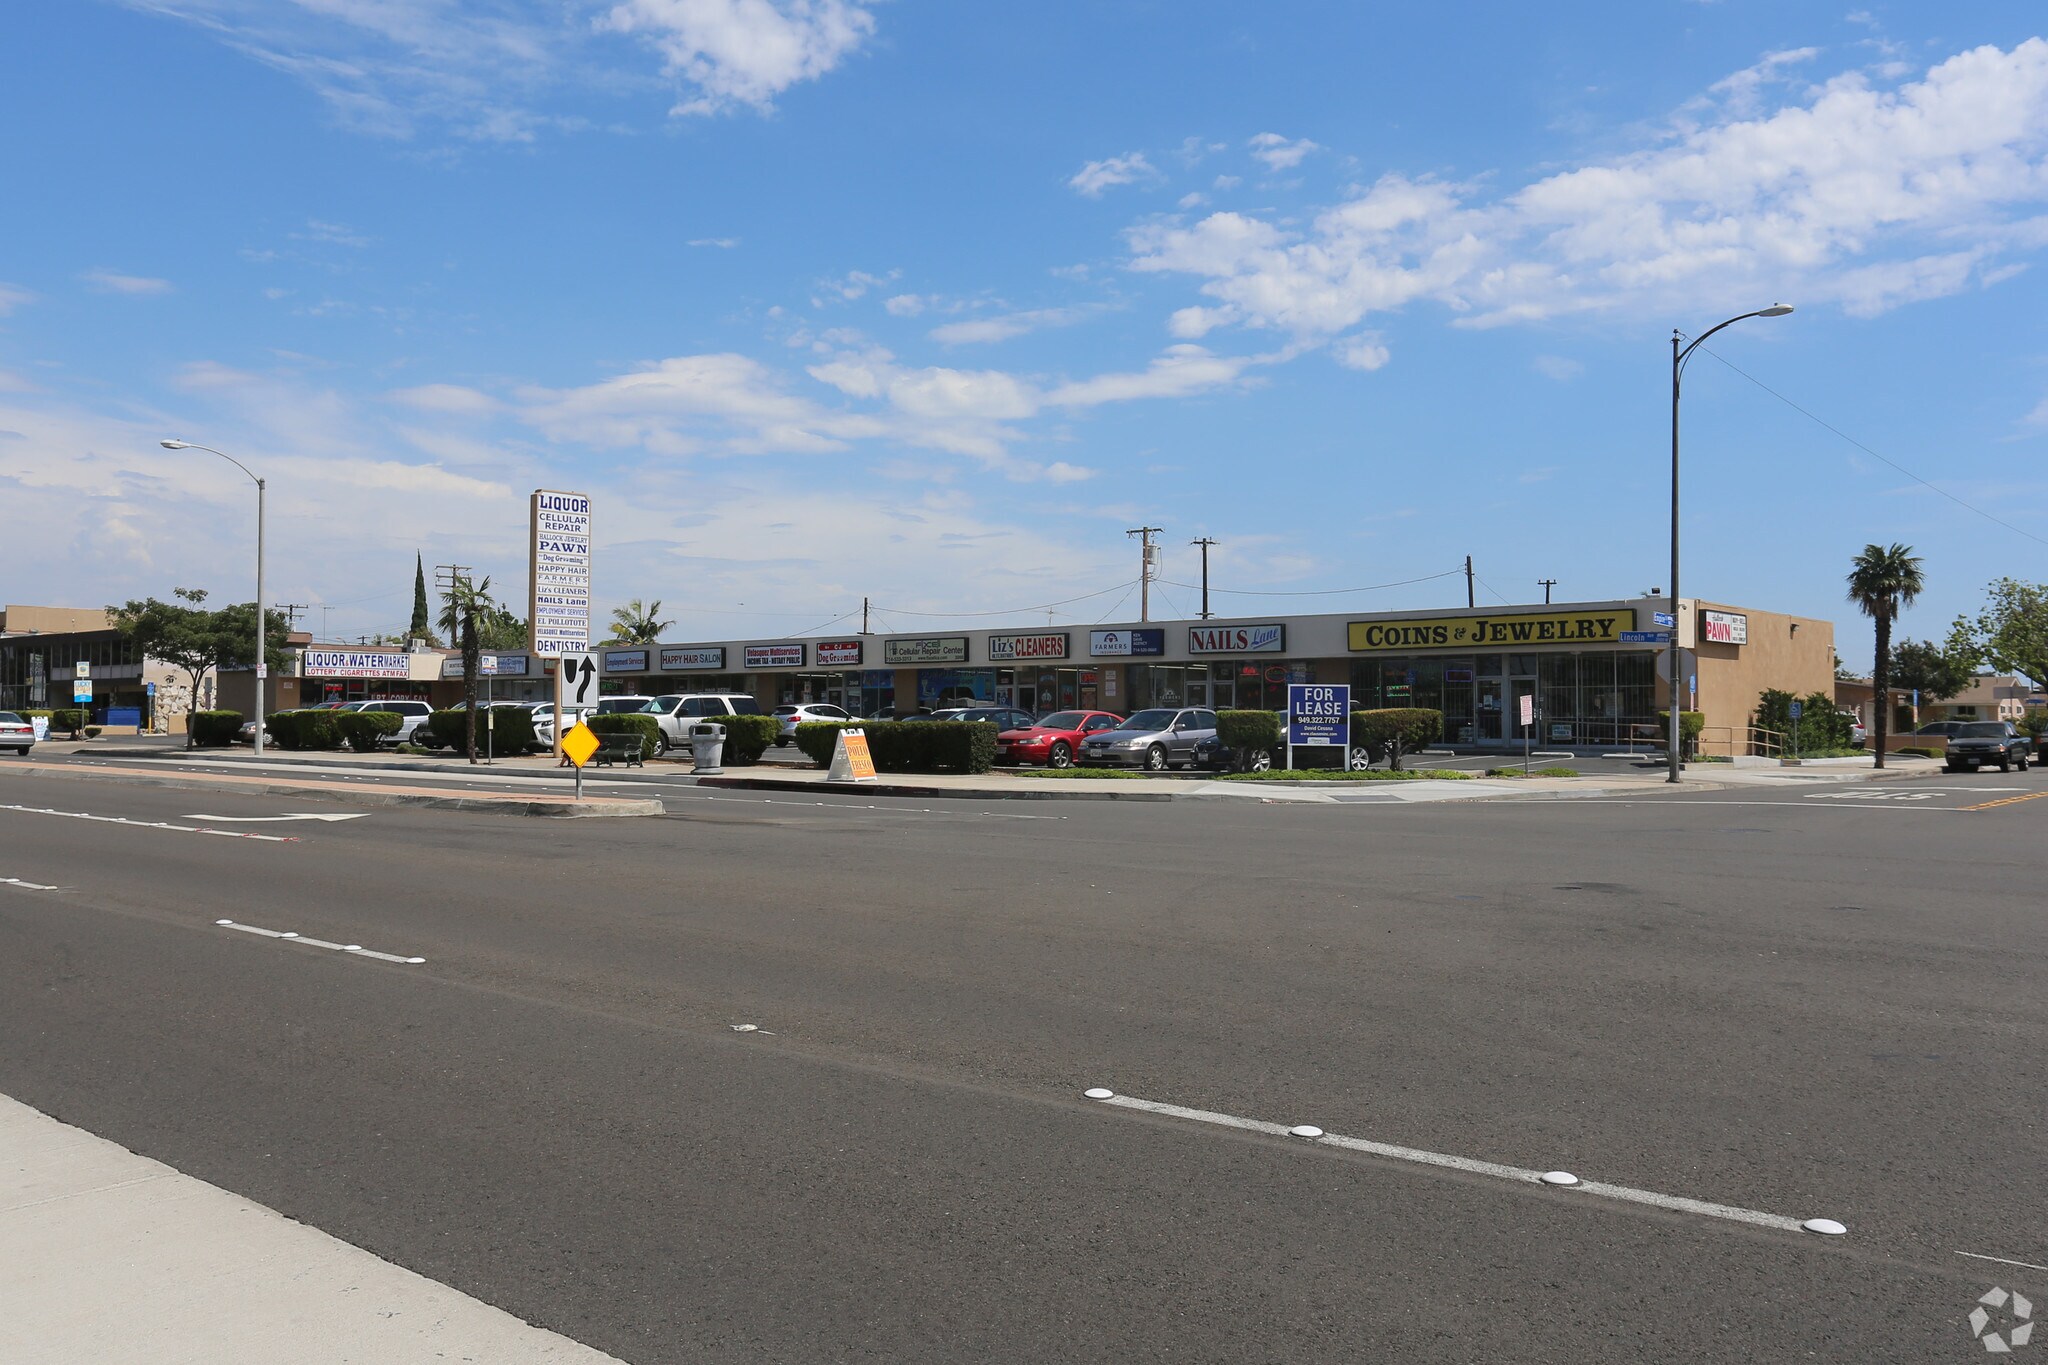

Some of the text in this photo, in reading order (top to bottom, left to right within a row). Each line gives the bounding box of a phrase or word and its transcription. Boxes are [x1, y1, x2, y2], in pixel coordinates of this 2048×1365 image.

[540, 495, 588, 513] LIQUOR
[540, 513, 587, 524] CELLULAR
[545, 522, 581, 532] REPAIR
[539, 541, 587, 553] PAWN
[538, 574, 587, 583] FARMERS
[536, 607, 566, 615] EMPLOYMENT
[1366, 618, 1616, 647] COINS & JEWELRY
[1706, 621, 1730, 641] PAWN
[1192, 628, 1278, 650] NAILS Lane
[1620, 633, 1645, 641] Lincoln
[538, 641, 586, 652] DENTISTRY
[922, 647, 941, 656] Repair
[992, 637, 1062, 656] Liz's CLEANERS
[747, 648, 801, 657] Velasquez Multiservices
[819, 653, 829, 663] Dog
[306, 653, 345, 666] LIQUOR
[349, 655, 384, 667] WATER
[384, 656, 408, 668] MARKET
[607, 658, 628, 666] Employment
[662, 654, 721, 665] HAPPY HAIR SALON
[1305, 688, 1333, 701] FOR
[1296, 702, 1342, 715] LEASE
[847, 746, 869, 756] POLLO
[851, 760, 872, 770] FRESCO
